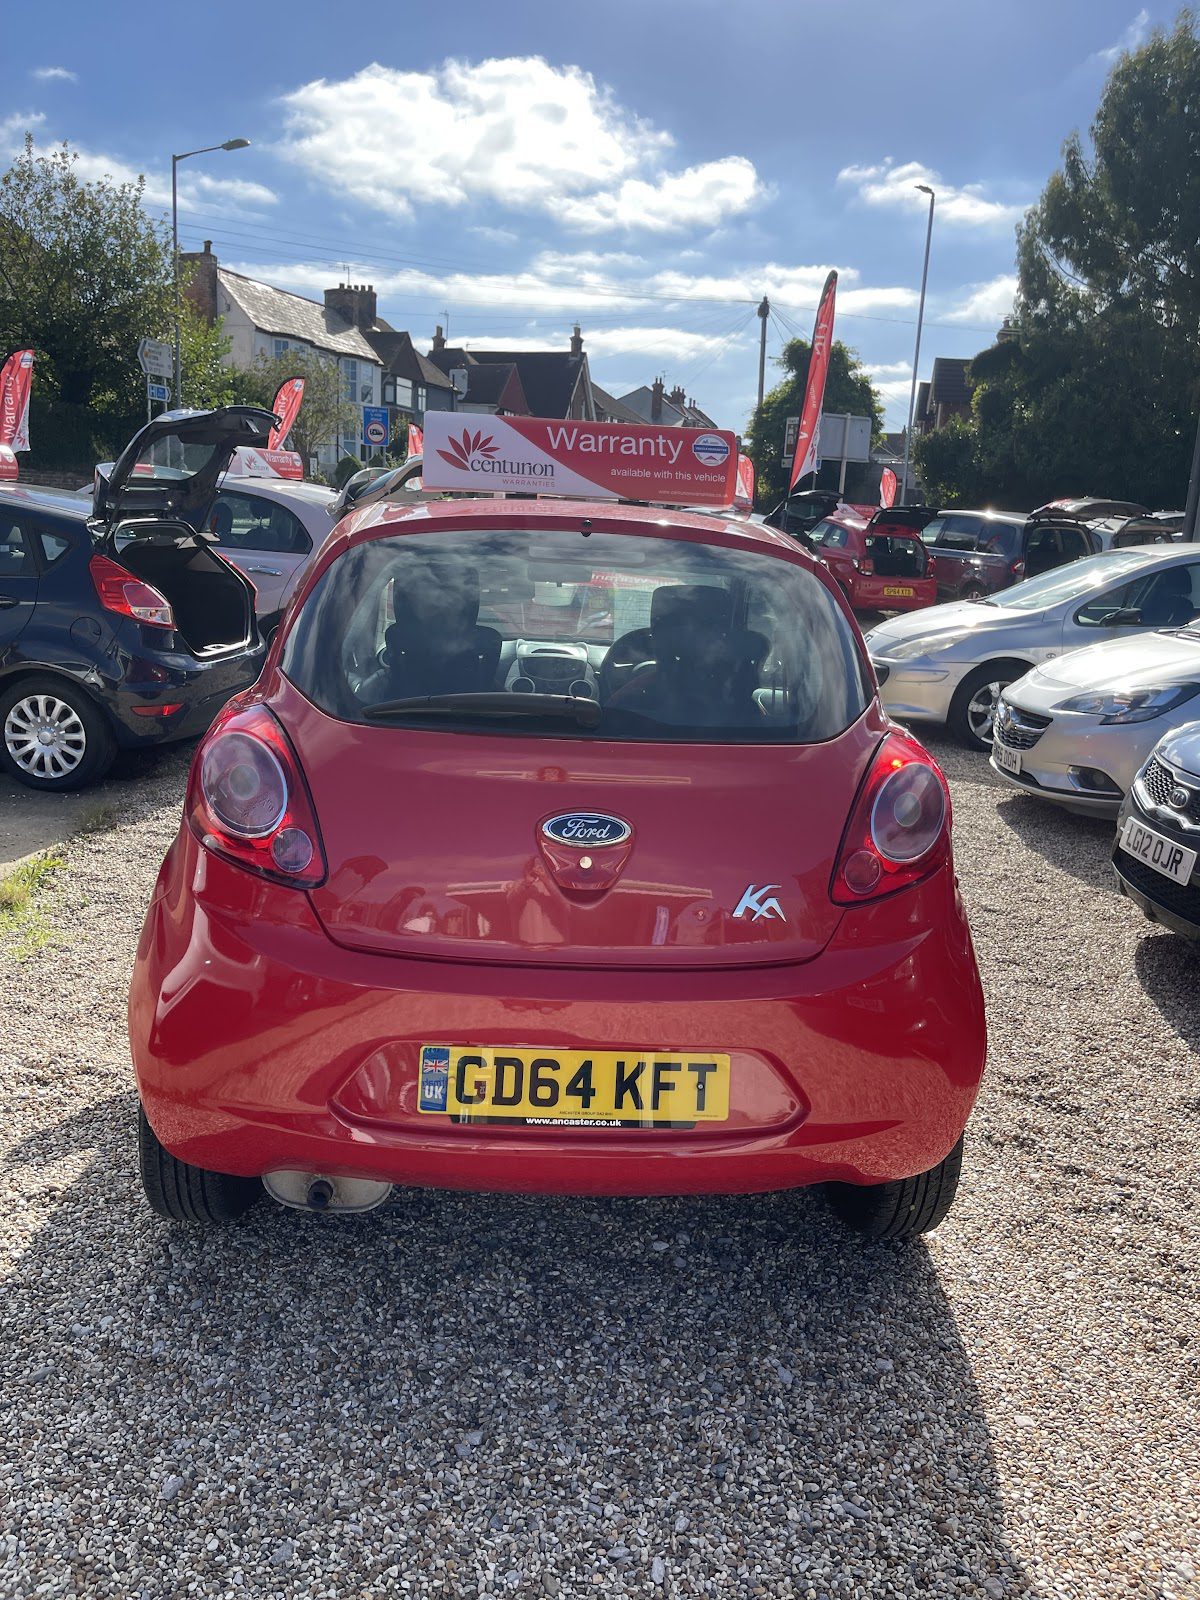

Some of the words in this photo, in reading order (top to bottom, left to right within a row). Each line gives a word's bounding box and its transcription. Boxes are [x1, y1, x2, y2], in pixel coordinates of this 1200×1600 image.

[4, 373, 15, 440] Warranty
[546, 426, 684, 464] Warranty
[469, 459, 555, 477] centurion
[610, 467, 651, 478] available
[652, 469, 673, 479] with
[674, 470, 694, 481] this
[695, 471, 726, 483] vehicle
[501, 478, 556, 488] WARRANTIES
[561, 817, 611, 840] Ford
[1125, 823, 1153, 858] LG12
[1151, 839, 1184, 875] OJR
[424, 1085, 443, 1099] UK
[455, 1055, 597, 1109] GD64
[614, 1060, 718, 1111] KFT
[525, 1116, 622, 1128] www.ancaster.co.uk
